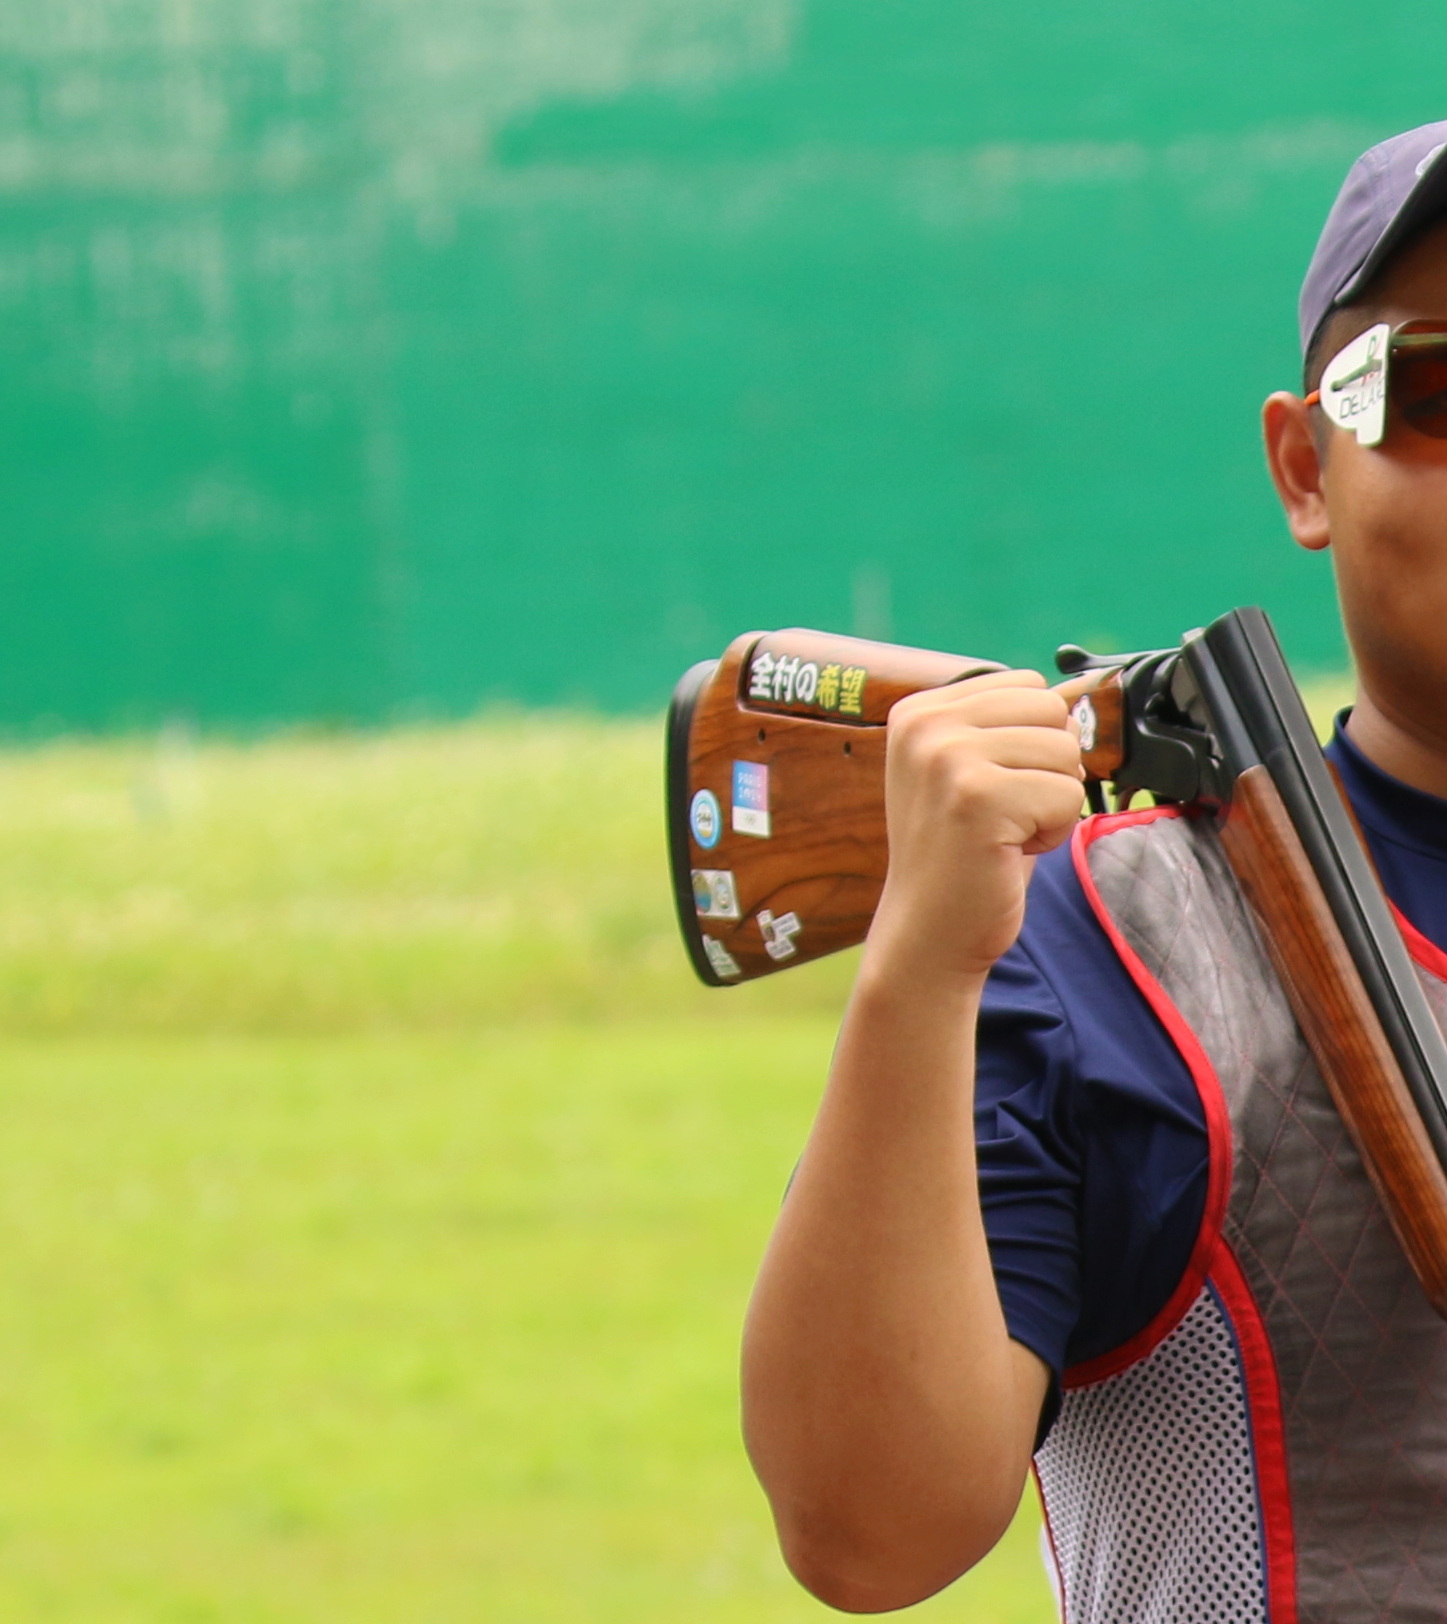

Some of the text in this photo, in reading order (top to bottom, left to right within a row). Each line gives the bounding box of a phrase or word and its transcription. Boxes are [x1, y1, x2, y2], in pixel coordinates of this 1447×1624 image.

[748, 651, 867, 715] 全村の希望
